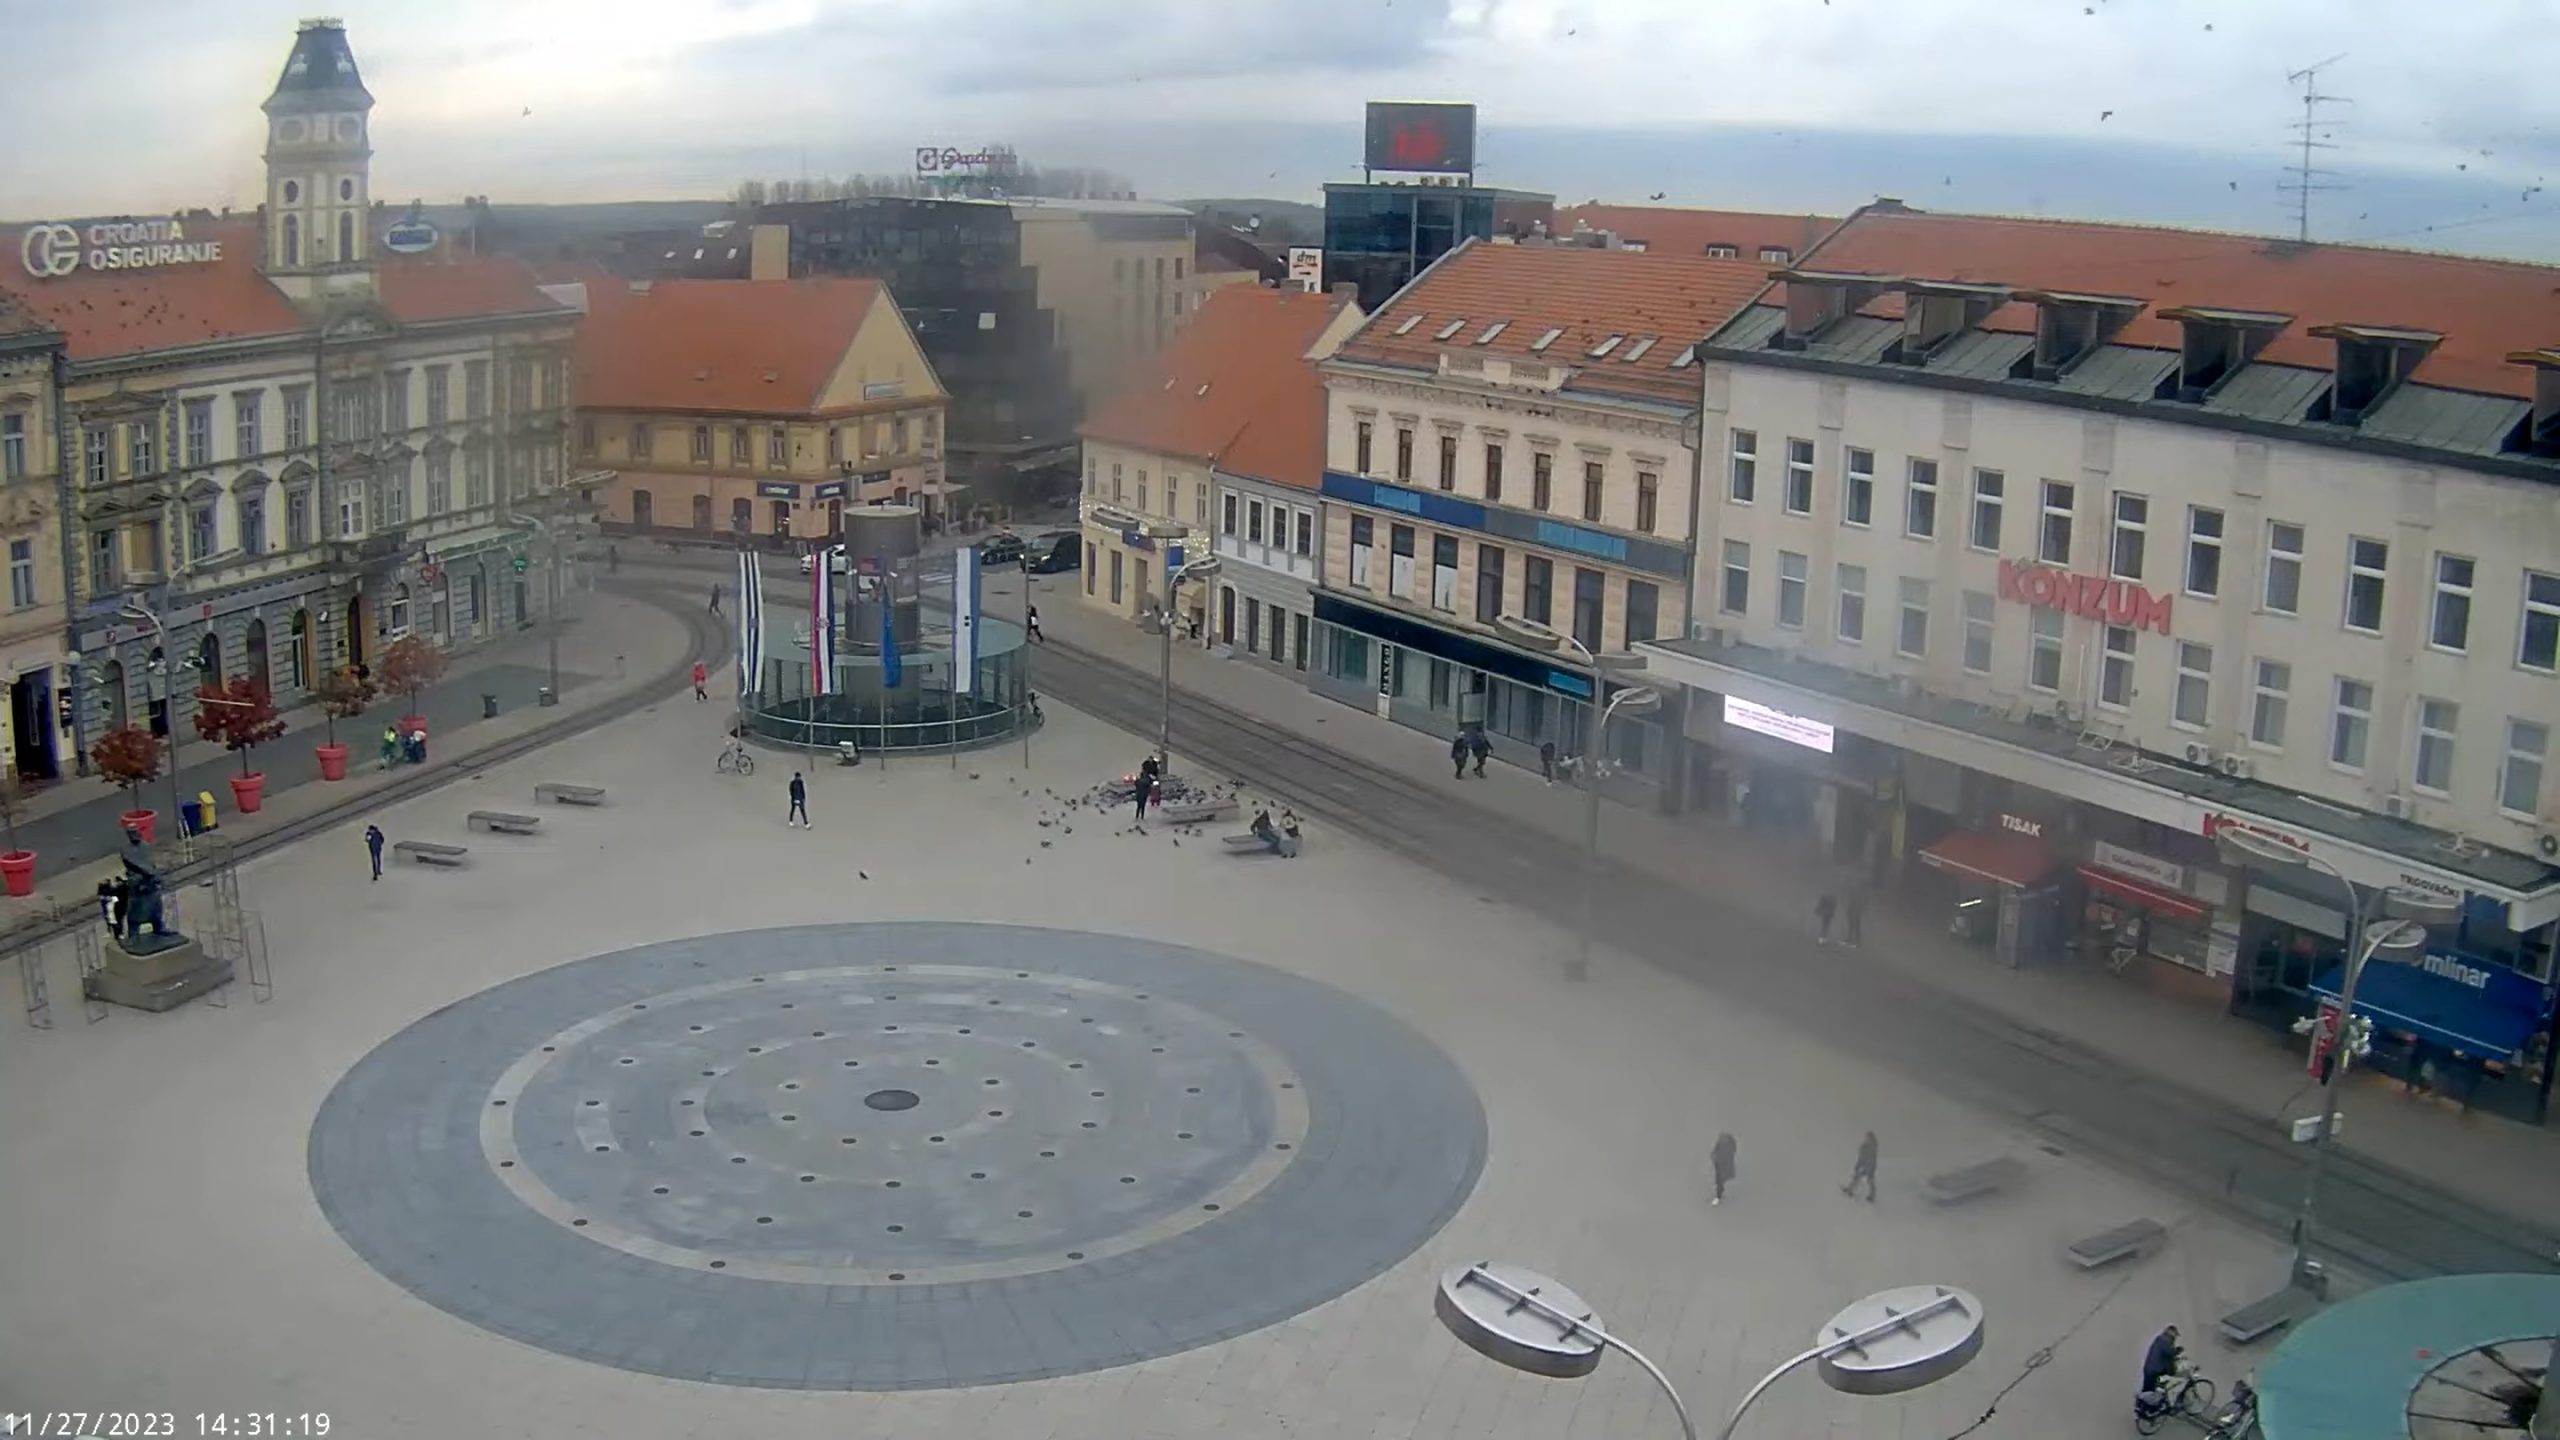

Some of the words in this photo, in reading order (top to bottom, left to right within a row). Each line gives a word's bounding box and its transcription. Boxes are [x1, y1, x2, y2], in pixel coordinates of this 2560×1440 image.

[90, 220, 184, 245] CROATIA
[90, 242, 222, 271] OSIGURANJE
[1999, 558, 2172, 636] KONZUM
[2001, 813, 2041, 838] TISAK
[2424, 954, 2491, 989] mlinar
